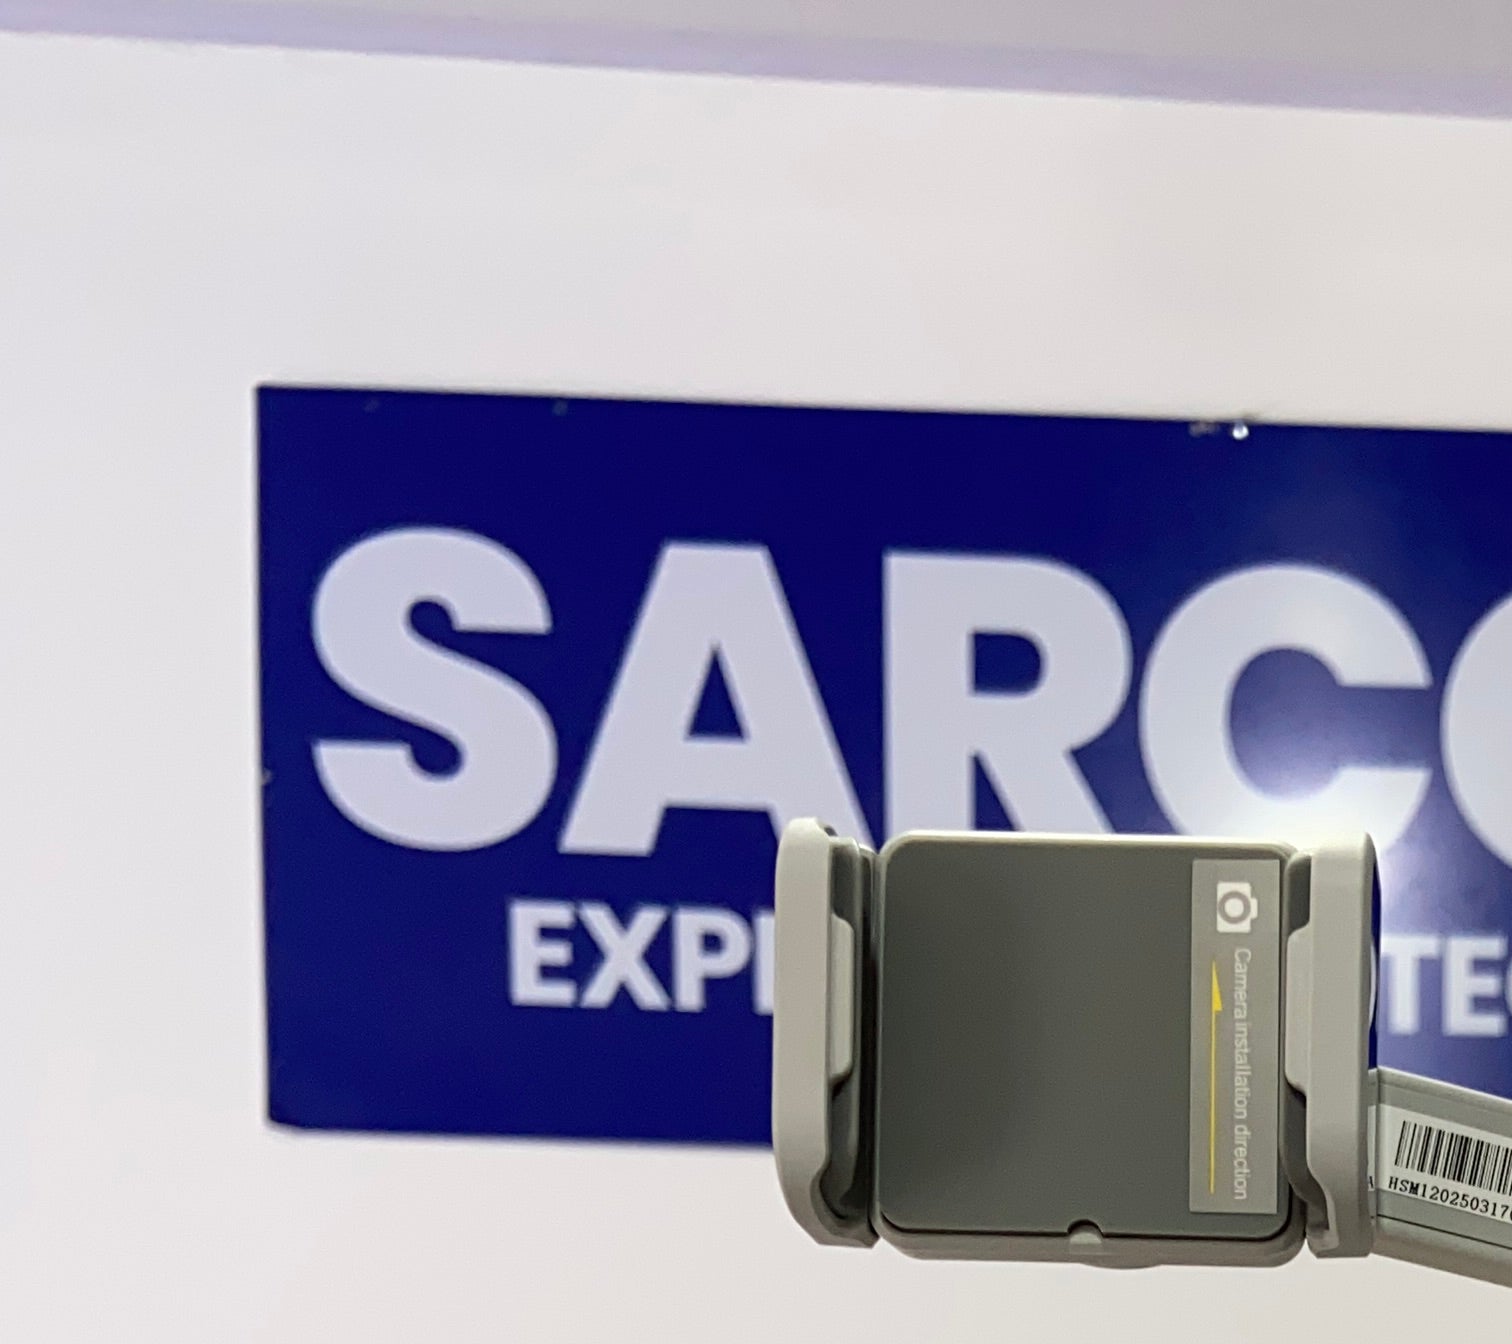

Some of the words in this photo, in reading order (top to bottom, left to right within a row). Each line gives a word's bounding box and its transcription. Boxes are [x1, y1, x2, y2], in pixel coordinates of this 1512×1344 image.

[1233, 947, 1252, 1019] Camera
[1233, 1022, 1252, 1120] installation
[1233, 1124, 1252, 1201] direction
